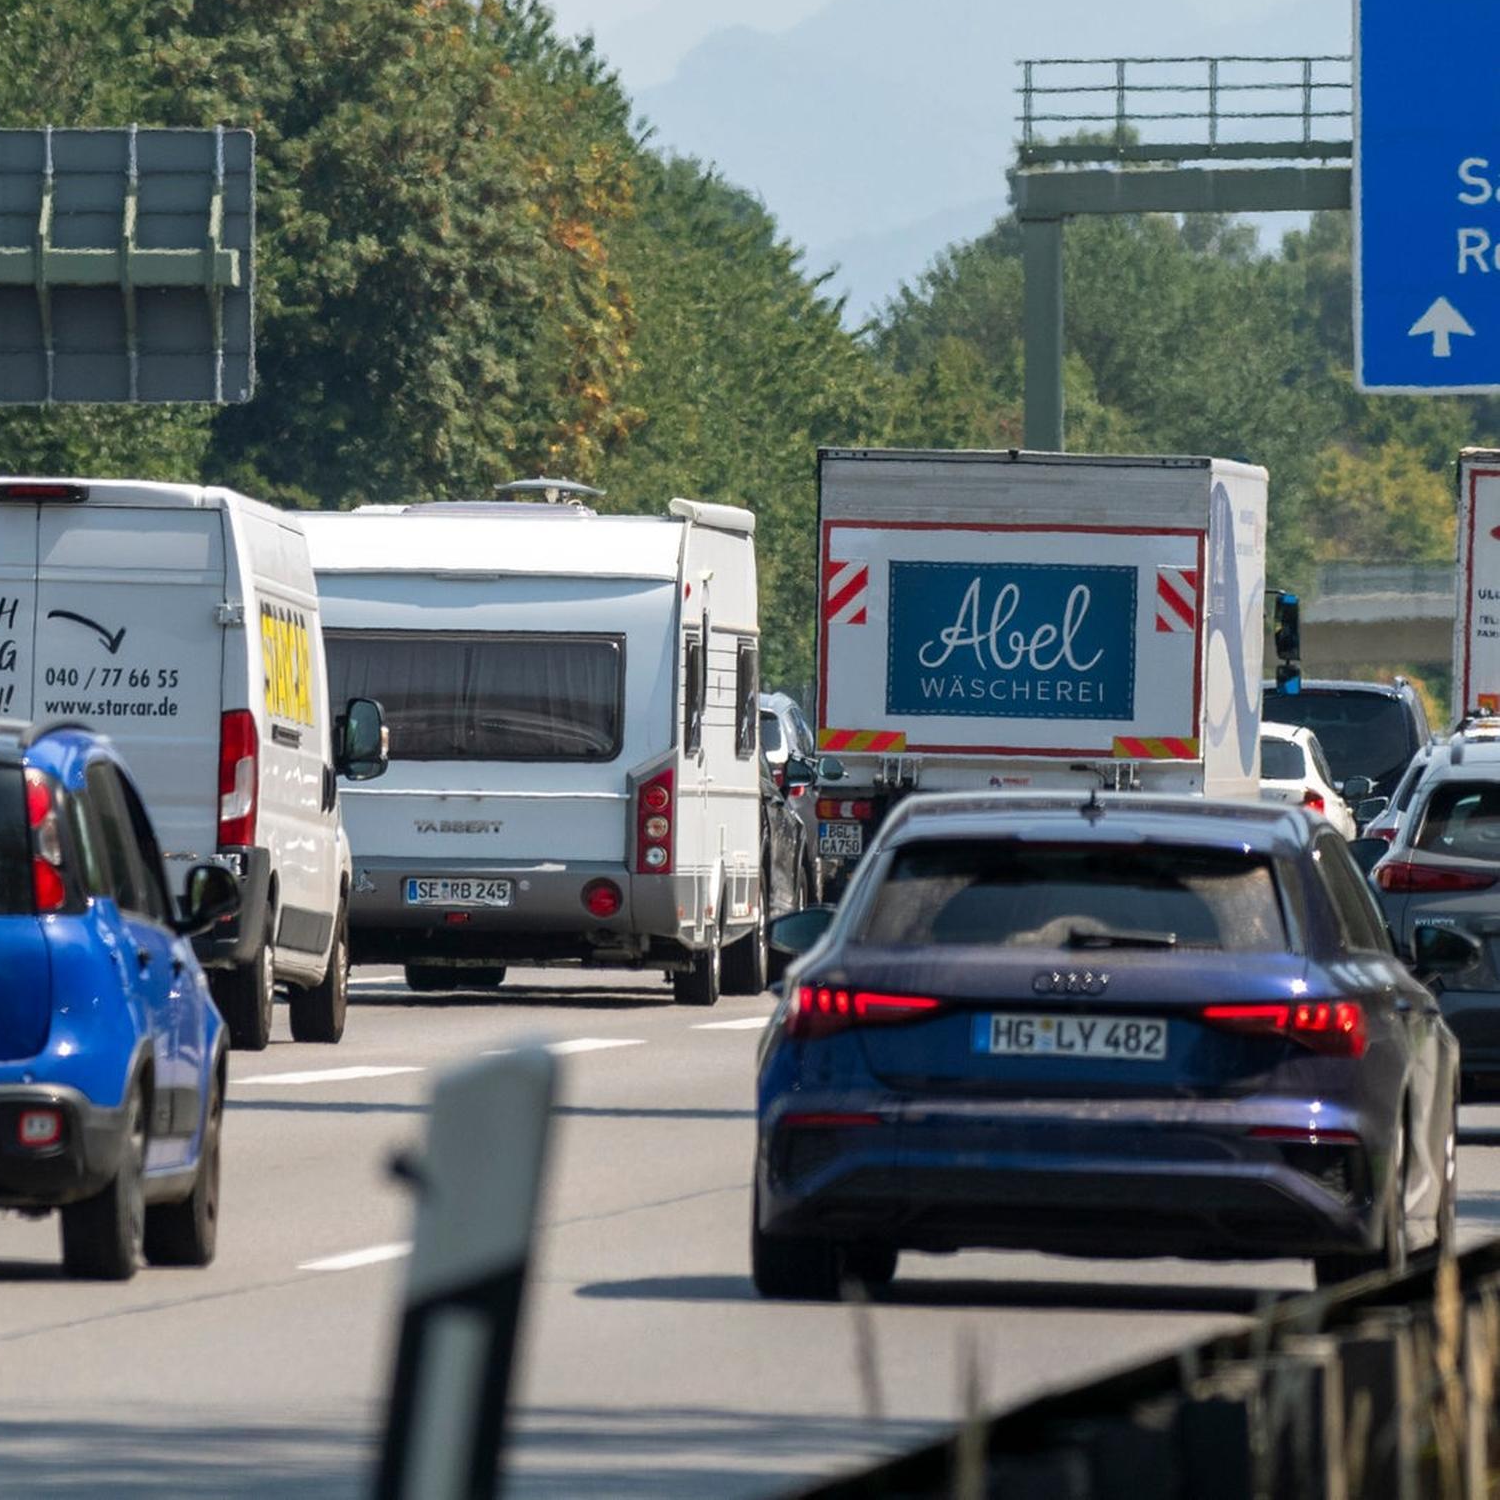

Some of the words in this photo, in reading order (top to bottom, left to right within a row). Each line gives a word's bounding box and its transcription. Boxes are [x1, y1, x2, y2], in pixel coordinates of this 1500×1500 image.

[1458, 157, 1500, 204] S
[1457, 227, 1500, 274] R
[918, 576, 1104, 672] Abel
[45, 667, 78, 686] 040
[101, 668, 123, 687] 77
[128, 668, 150, 688] 66
[157, 669, 179, 688] 55
[920, 675, 1104, 702] WÄSCHEREI
[45, 696, 178, 716] www.starcar.de
[476, 883, 508, 900] 245
[1104, 1023, 1162, 1054] 482
